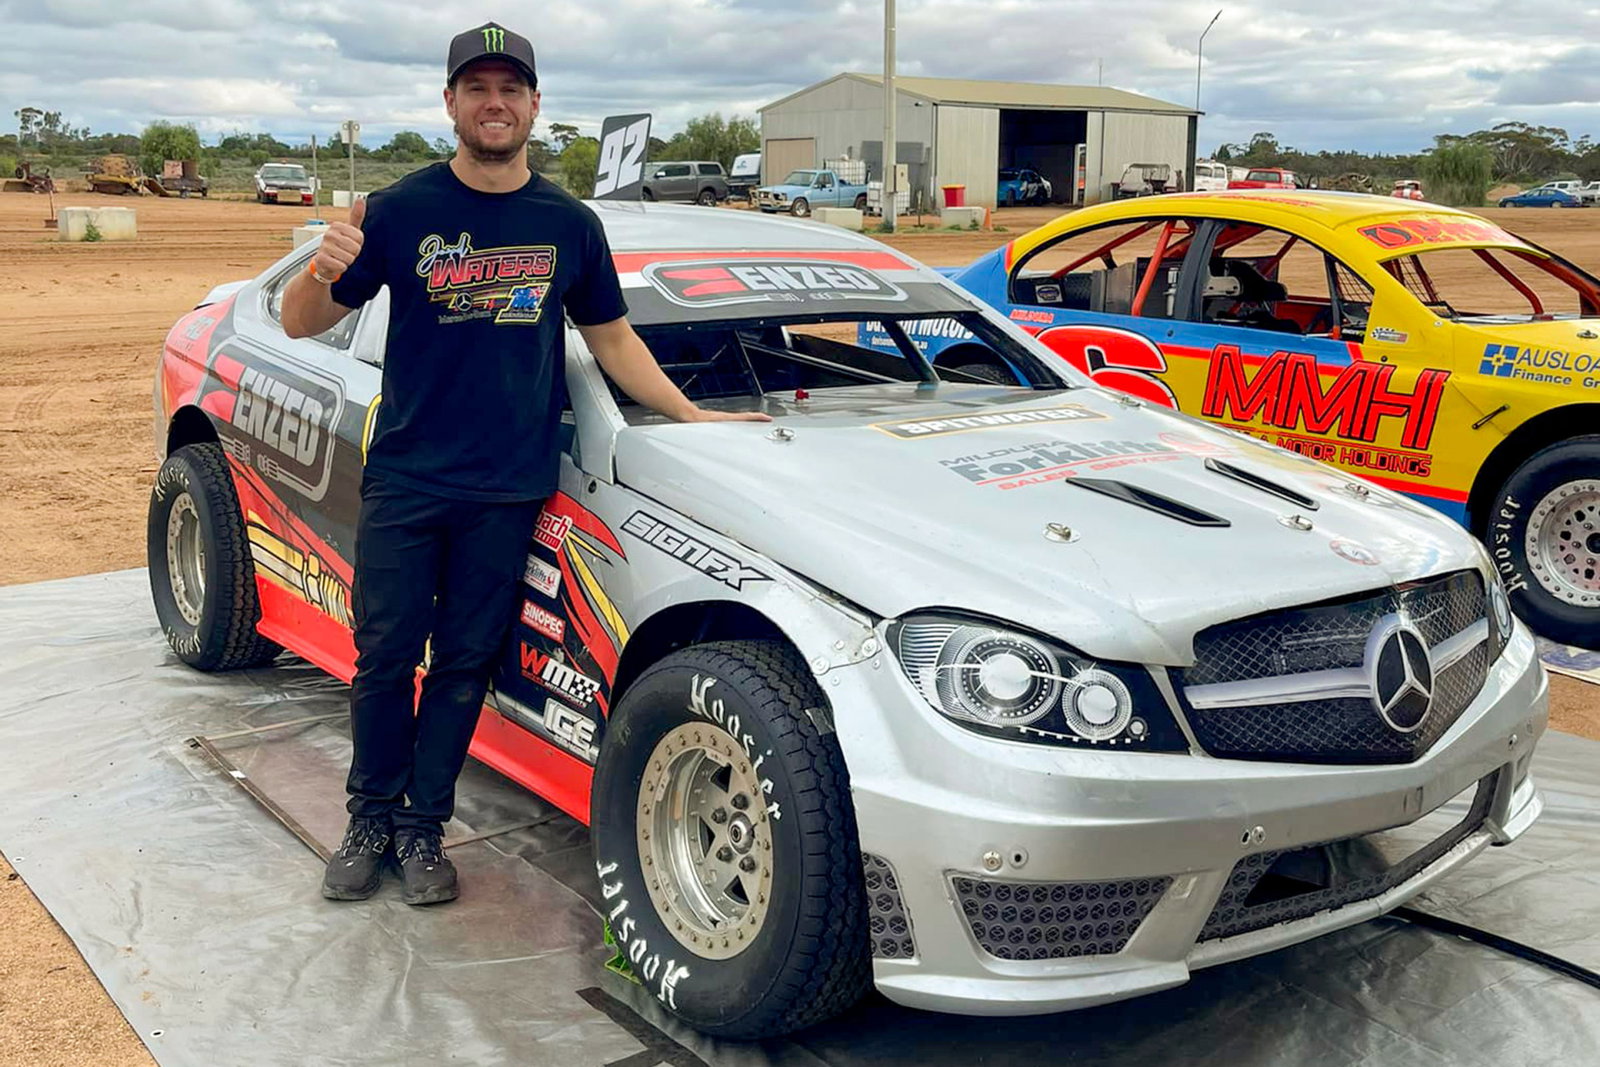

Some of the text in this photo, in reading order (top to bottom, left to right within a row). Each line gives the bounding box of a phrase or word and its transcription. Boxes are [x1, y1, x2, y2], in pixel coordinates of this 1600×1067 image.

[593, 116, 650, 199] 92
[430, 252, 552, 289] WATERS
[728, 266, 881, 291] ENZED
[1512, 368, 1573, 385] Finance
[1201, 343, 1452, 451] MMH
[233, 366, 324, 467] ENZED
[897, 408, 1089, 435] SPITWATER
[938, 440, 1071, 467] MILDURA
[1339, 446, 1433, 477] HOLDINGS
[997, 469, 1079, 491] SALES
[523, 601, 563, 635] SINOPEC
